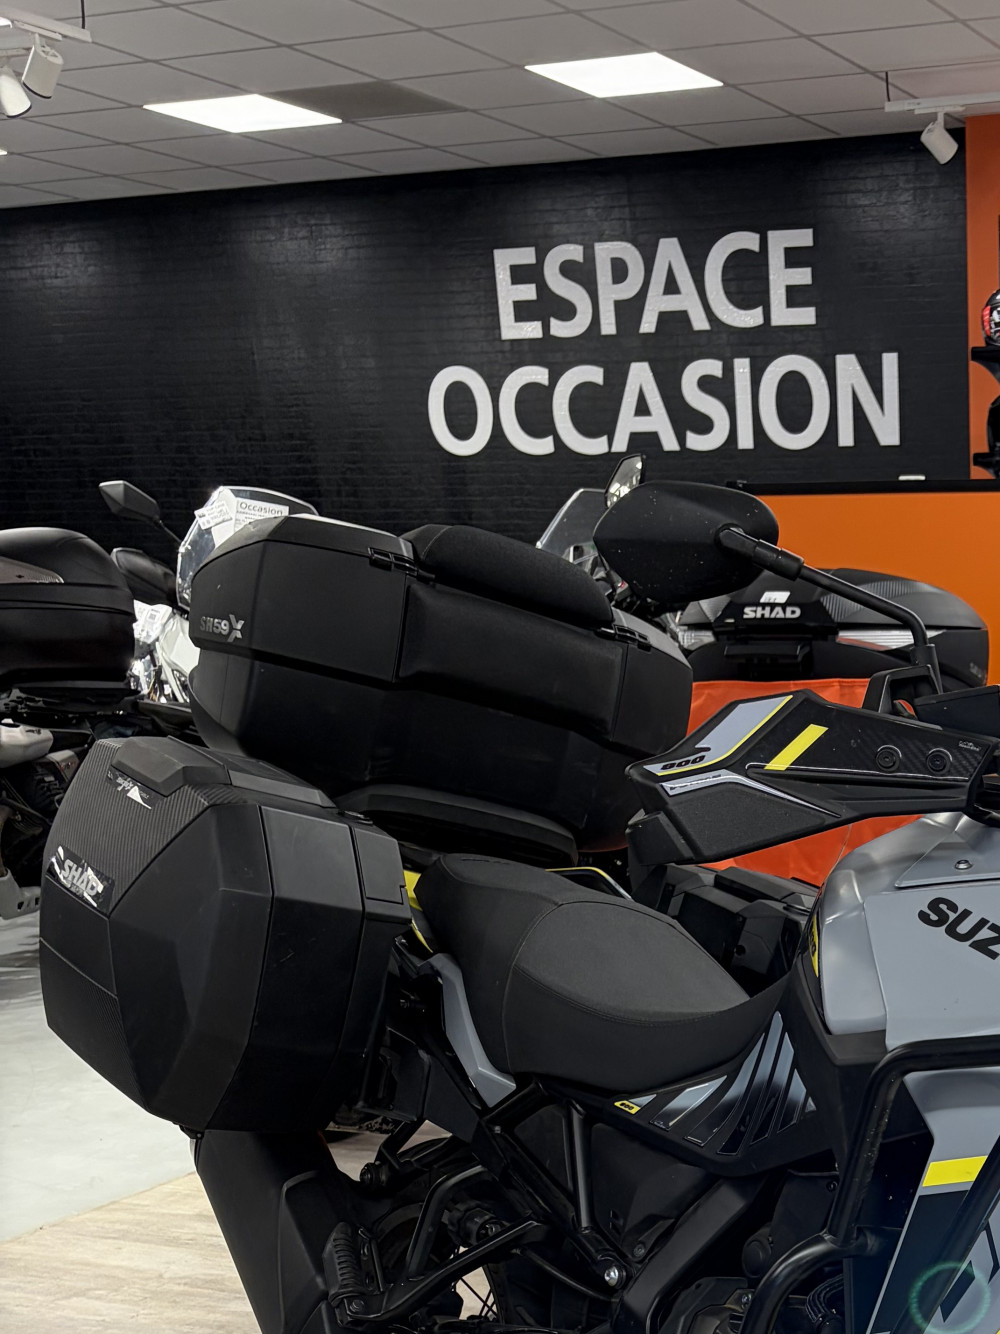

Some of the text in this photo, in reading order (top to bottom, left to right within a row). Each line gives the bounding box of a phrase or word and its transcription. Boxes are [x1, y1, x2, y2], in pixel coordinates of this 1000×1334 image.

[493, 228, 817, 341] ESPACE
[427, 351, 902, 457] OCCASION
[239, 501, 283, 516] Occasion
[743, 606, 801, 619] SHAD
[60, 859, 99, 896] SHAD
